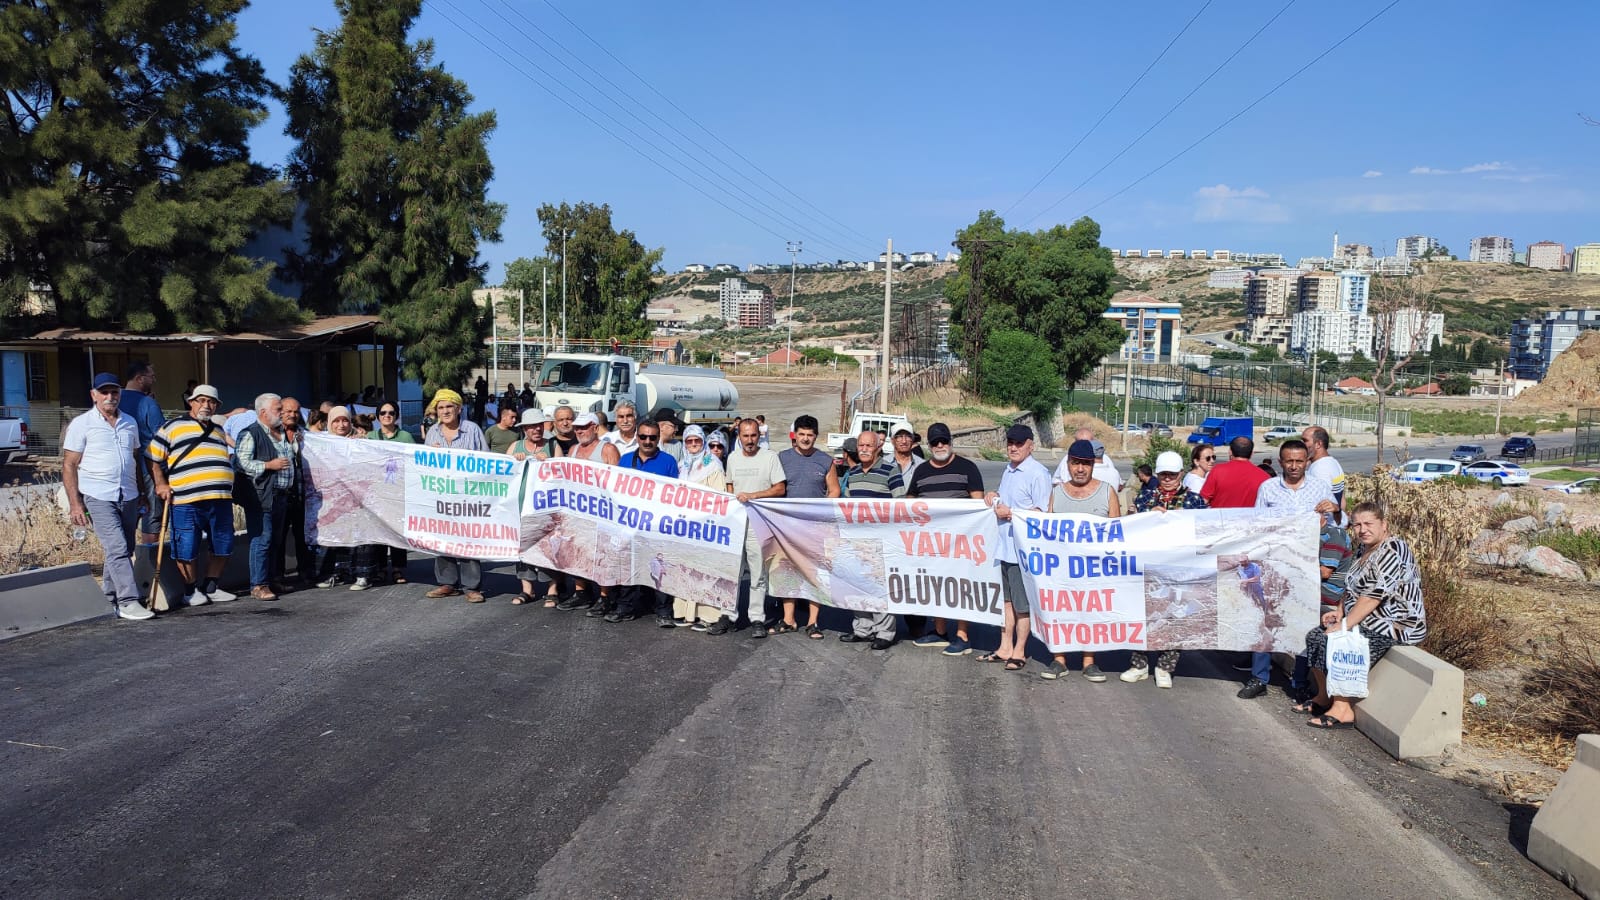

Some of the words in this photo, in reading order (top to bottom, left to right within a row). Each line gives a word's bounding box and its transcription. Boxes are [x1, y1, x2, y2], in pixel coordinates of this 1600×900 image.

[414, 450, 451, 469] MAVİ
[456, 453, 514, 476] KÖRFEZ
[420, 475, 459, 495] YEŞİL
[464, 477, 509, 498] İZMİR
[538, 461, 611, 490] ÇEVREYİ
[613, 474, 656, 500] HOR
[660, 483, 730, 516] GÖREN
[436, 500, 492, 518] DEDİNİZ
[533, 488, 613, 521] GELECEĞİ
[617, 505, 654, 532] ZOR
[659, 514, 731, 546] GÖRÜR
[837, 501, 932, 527] YAVAŞ
[408, 515, 519, 542] HARMANDALINI
[1026, 517, 1126, 543] BURAYA
[899, 531, 987, 567] YAVAŞ
[1068, 551, 1143, 578] DEĞİL
[888, 567, 1003, 615] ÖLÜYORUZ
[1039, 588, 1116, 612] HAYAT
